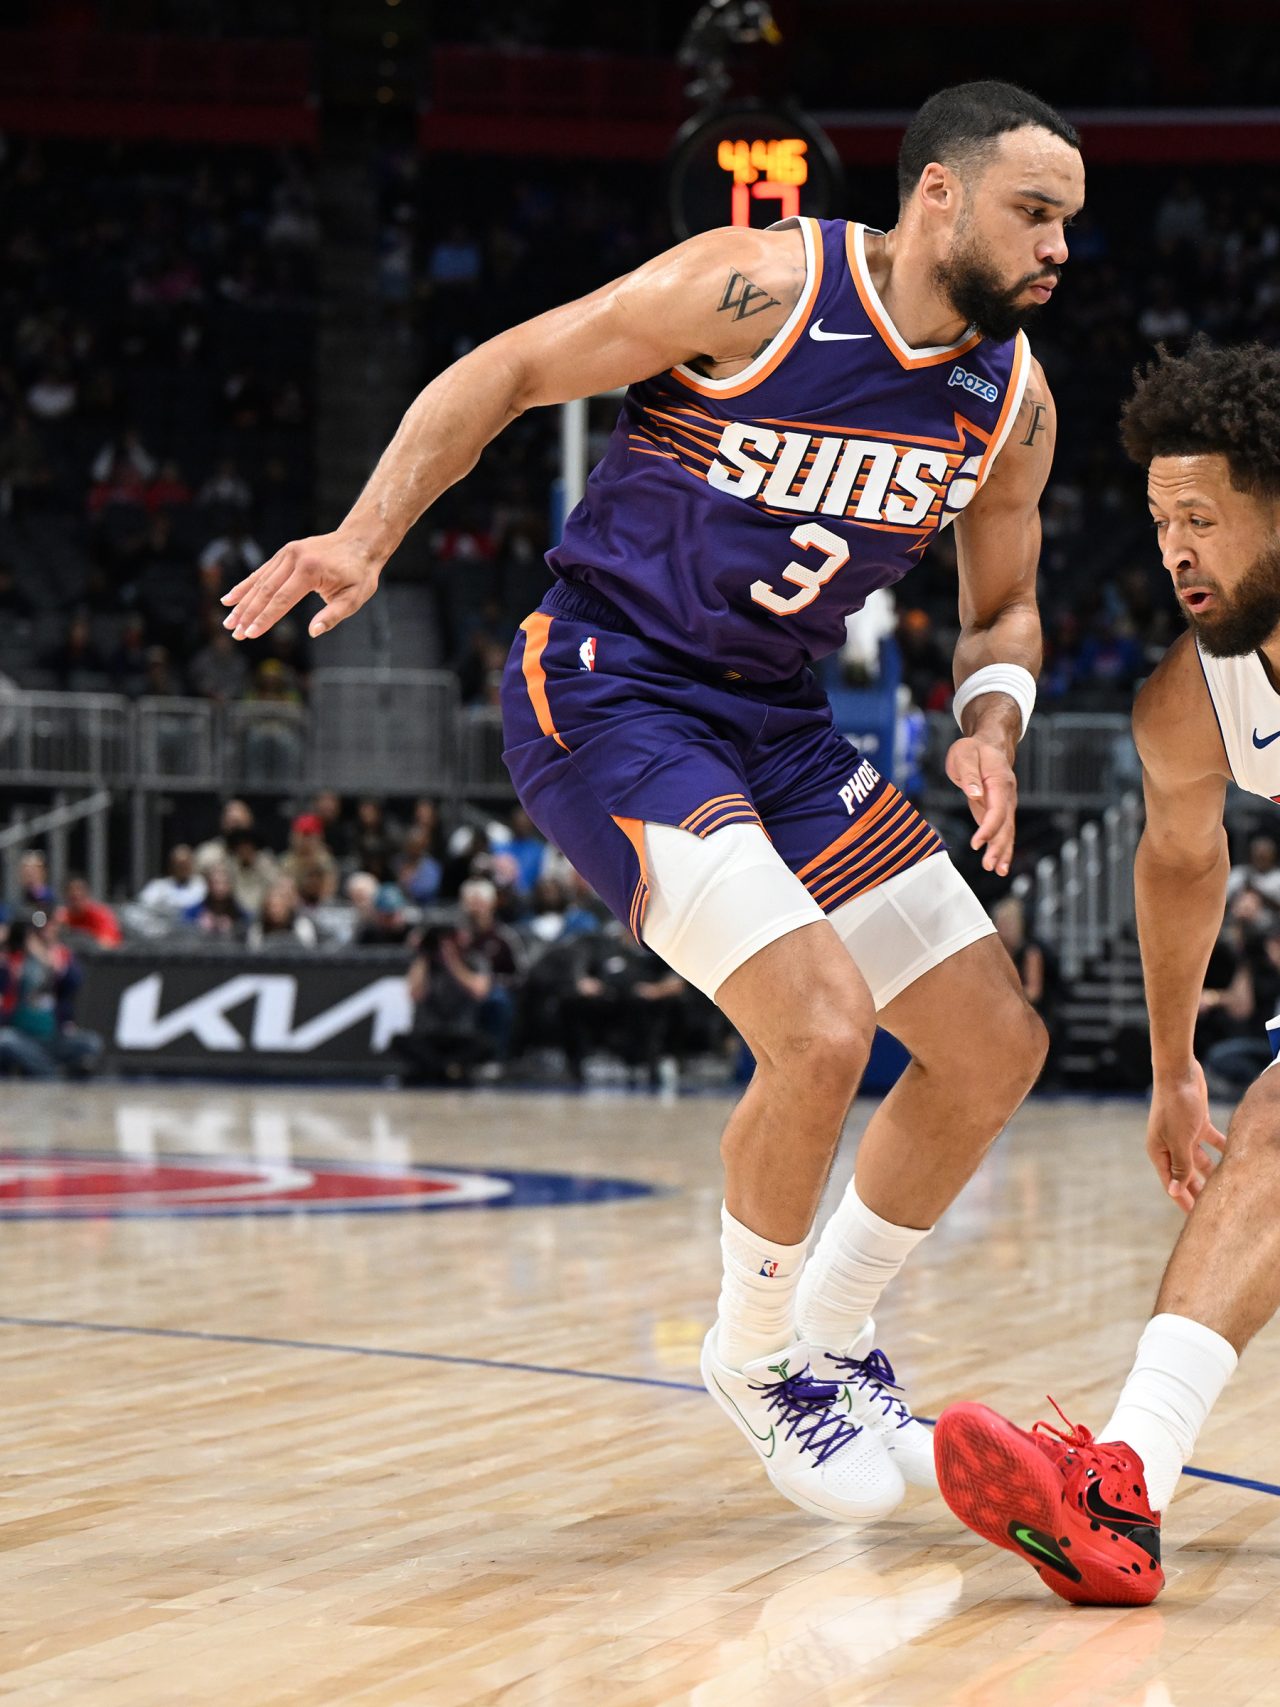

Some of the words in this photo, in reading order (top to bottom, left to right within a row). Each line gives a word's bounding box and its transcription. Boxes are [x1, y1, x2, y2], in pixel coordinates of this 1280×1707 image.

[947, 365, 999, 403] paze
[706, 421, 949, 526] SUNS
[750, 522, 850, 616] 3
